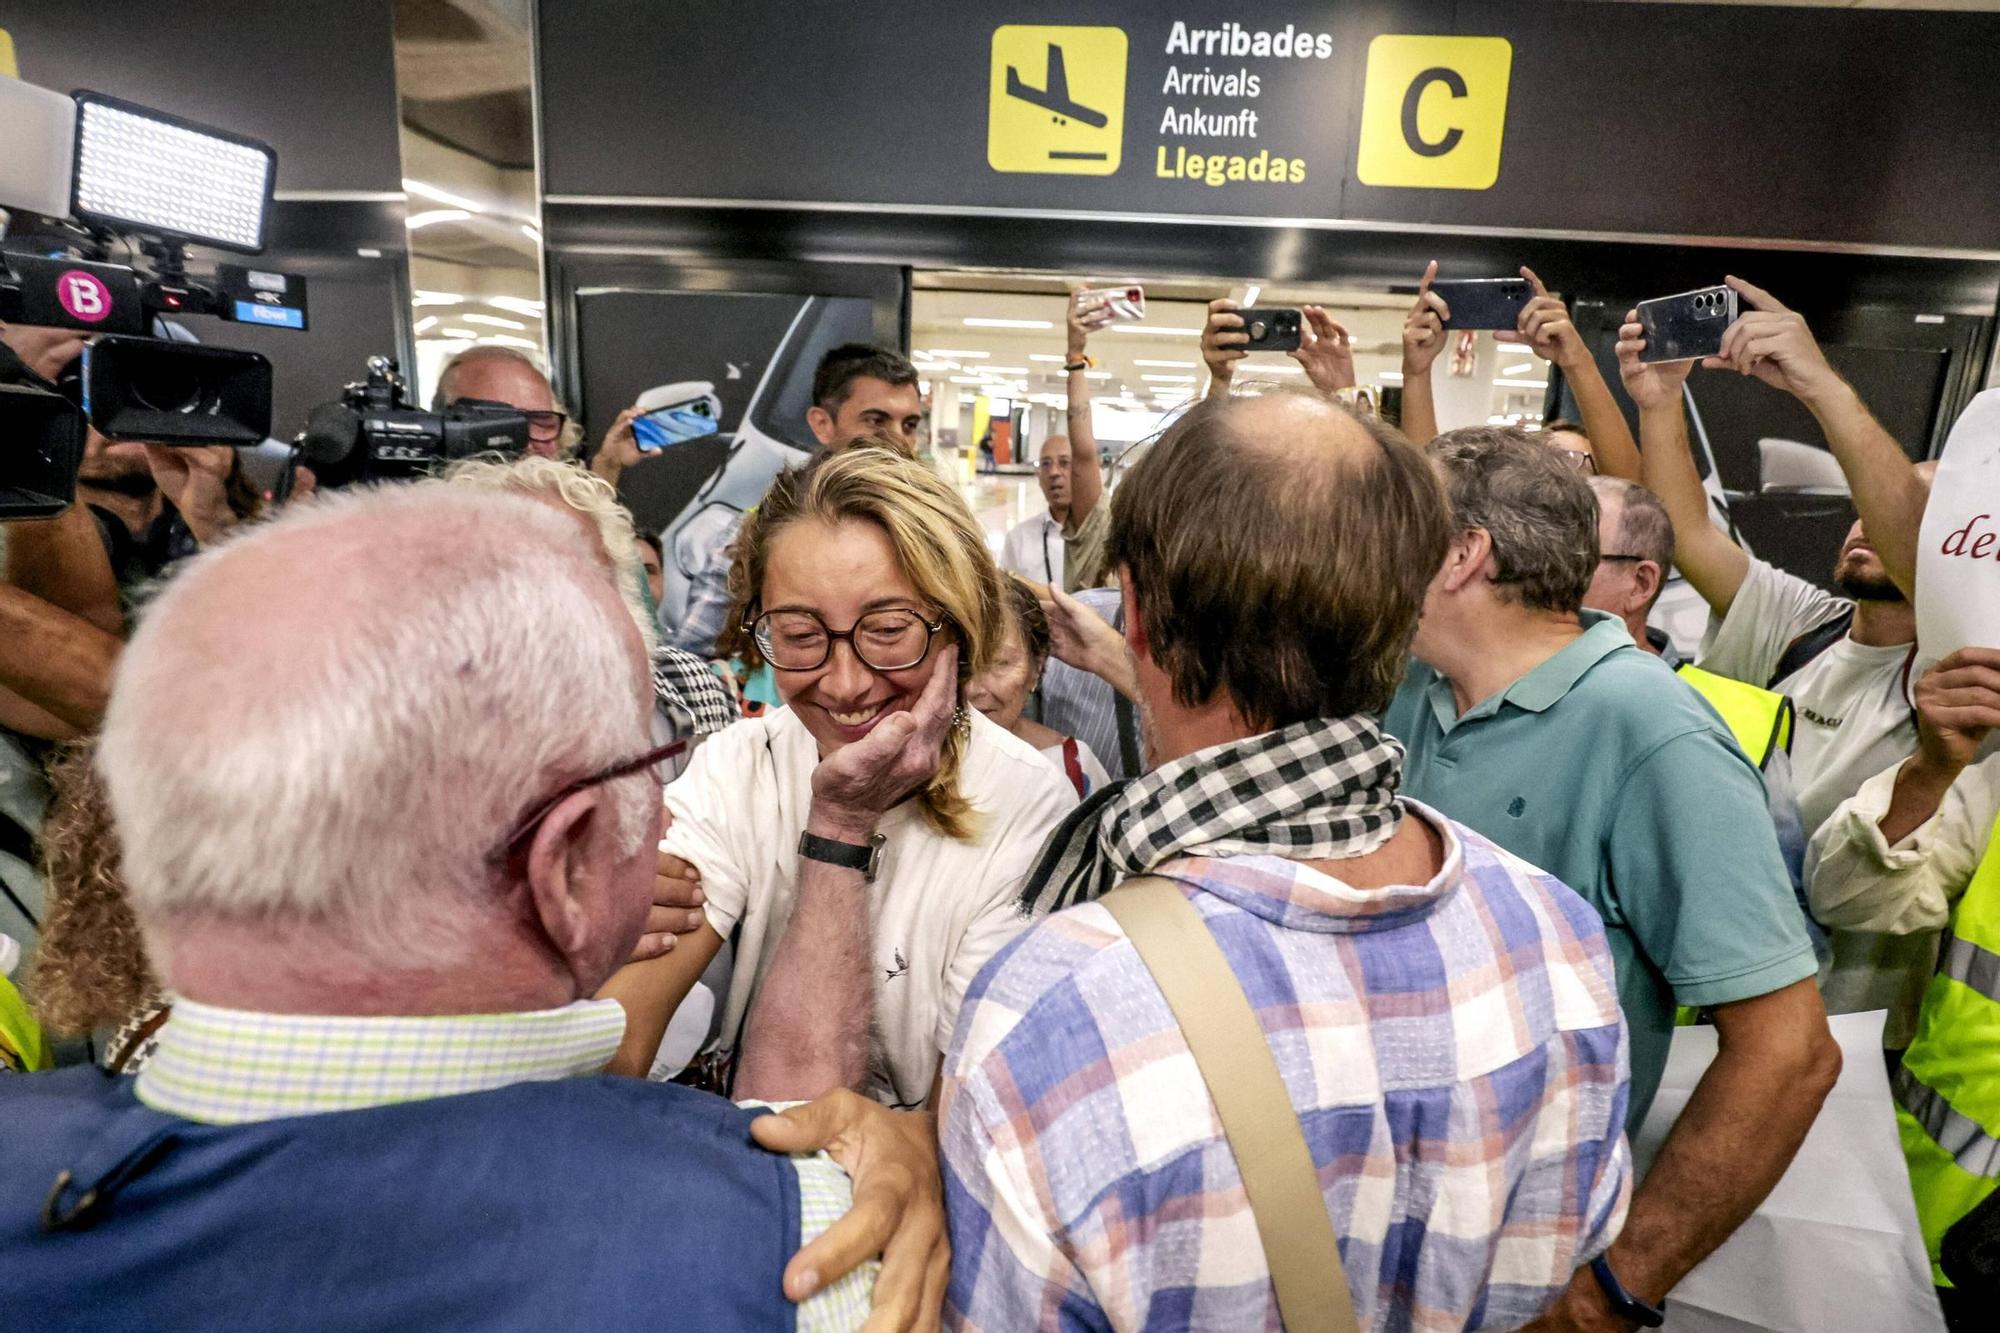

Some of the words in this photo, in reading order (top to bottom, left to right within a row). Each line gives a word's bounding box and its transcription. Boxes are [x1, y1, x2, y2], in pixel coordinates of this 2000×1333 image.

[1165, 20, 1333, 60] Arribades
[1162, 65, 1261, 98] Arrivals
[1159, 105, 1259, 138] Ankunft
[1401, 67, 1468, 157] C
[1156, 146, 1307, 187] Llegadas
[1941, 514, 2000, 562] de
